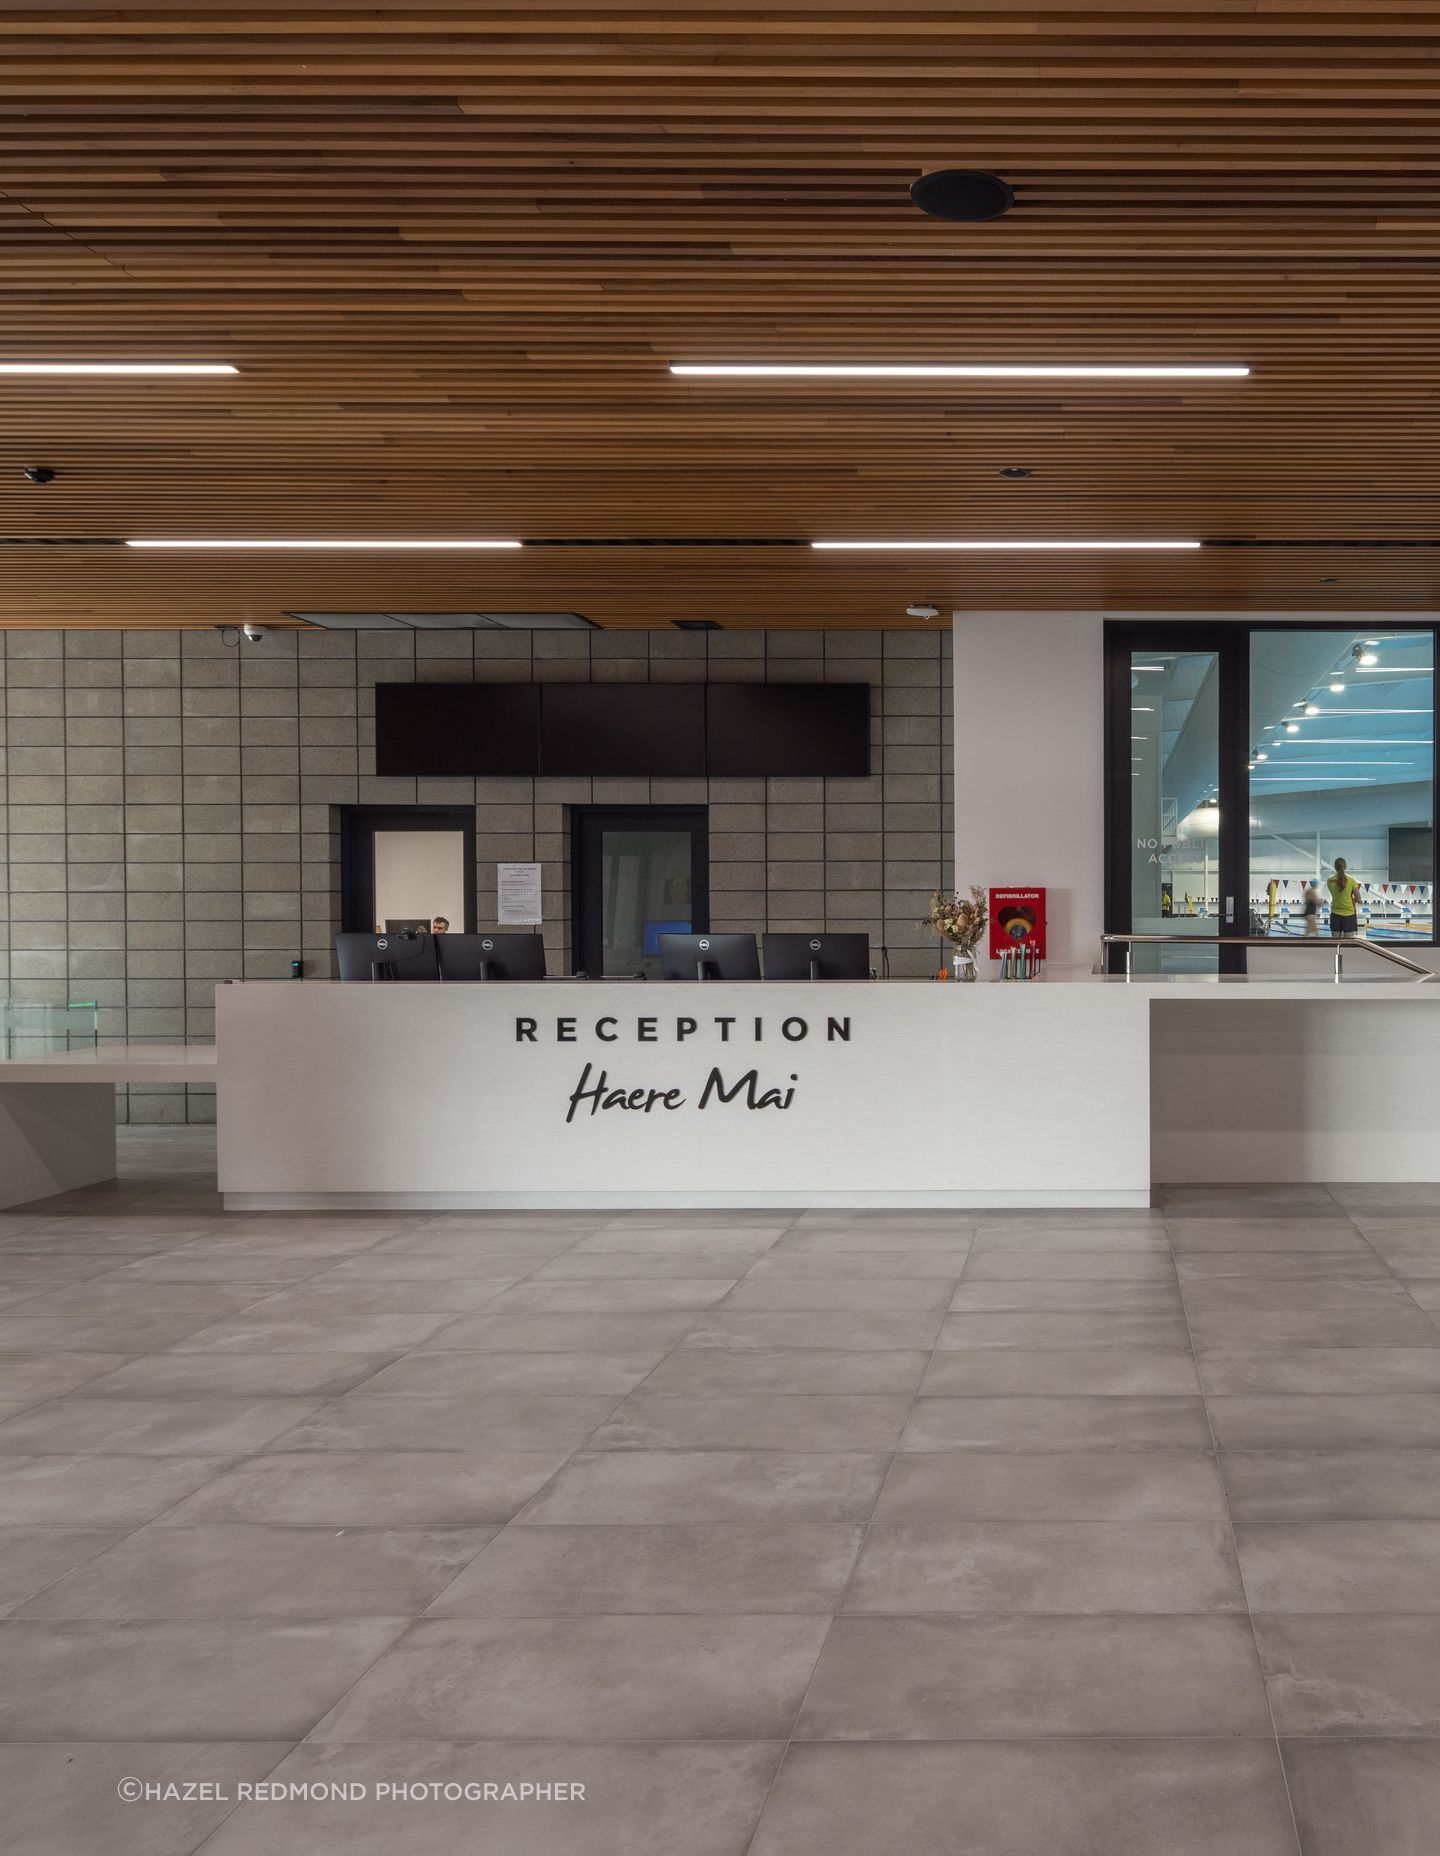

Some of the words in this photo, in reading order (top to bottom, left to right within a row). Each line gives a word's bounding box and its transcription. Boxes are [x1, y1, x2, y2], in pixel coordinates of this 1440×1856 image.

[1137, 838, 1158, 849] NO
[515, 1016, 852, 1042] RECEPTION
[565, 1062, 687, 1123] Haere
[697, 1066, 798, 1111] Mai
